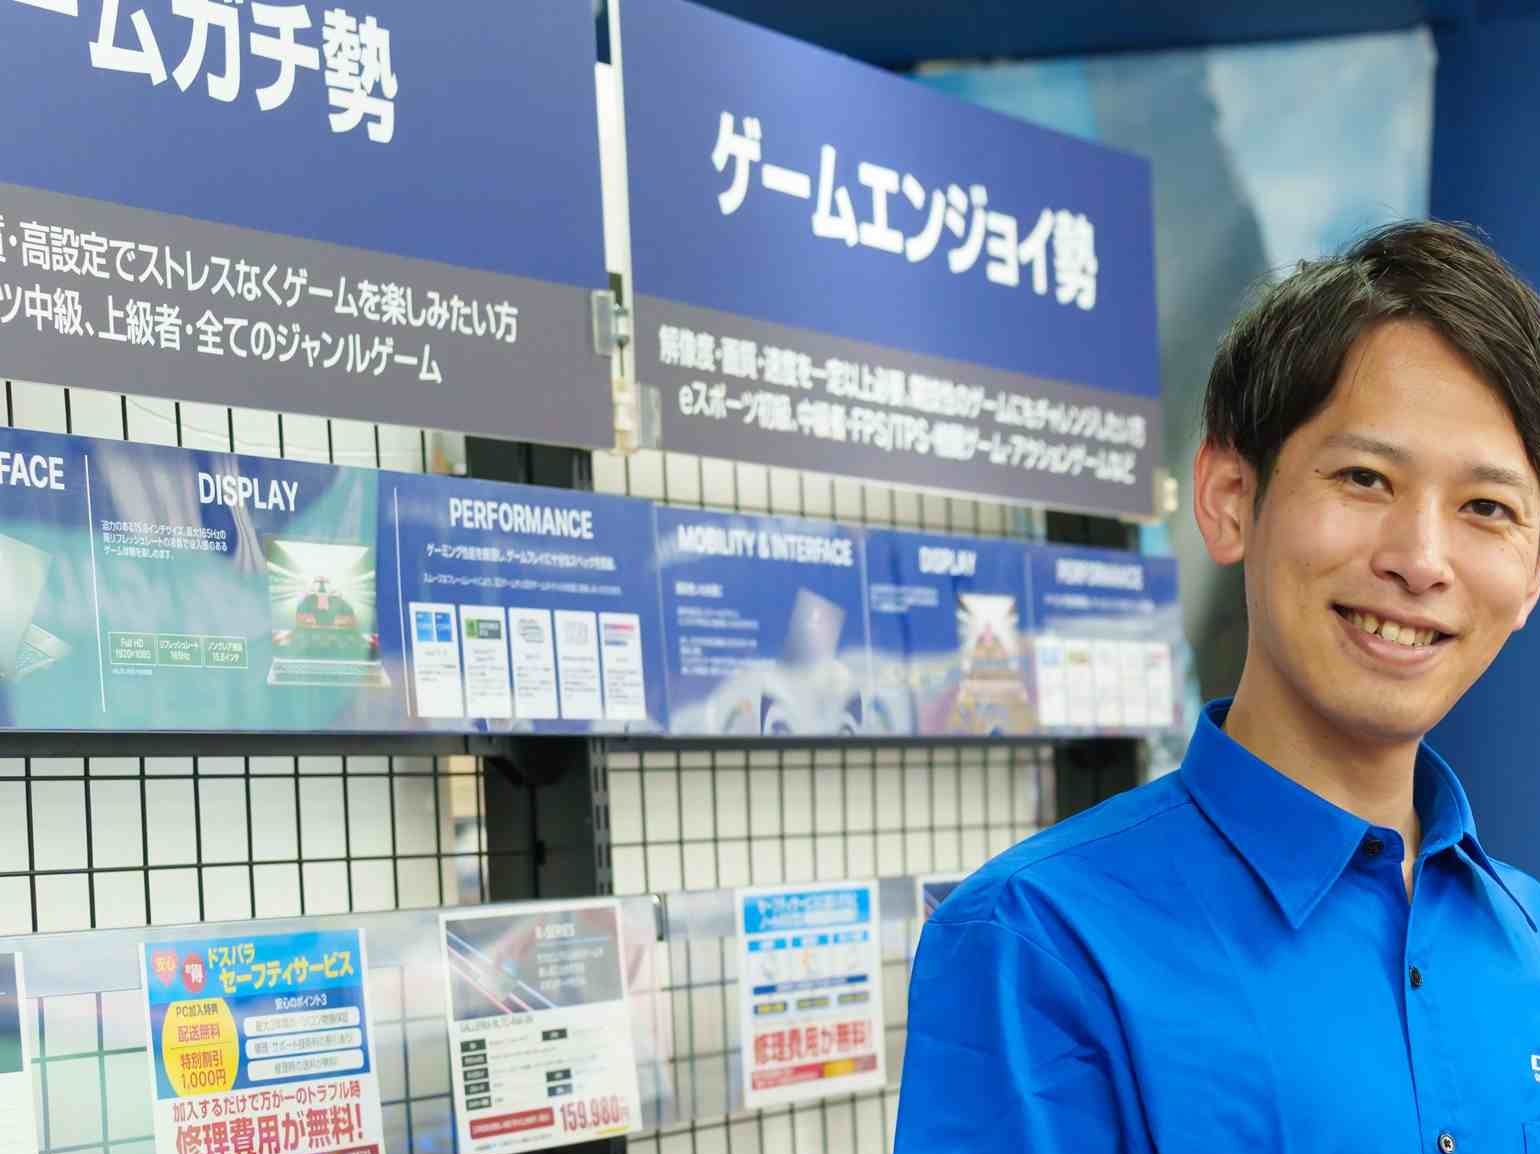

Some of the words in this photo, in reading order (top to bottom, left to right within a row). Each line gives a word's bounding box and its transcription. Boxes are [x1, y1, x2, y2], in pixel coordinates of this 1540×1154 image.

[12, 0, 399, 144] ムガチ勢
[712, 111, 1097, 310] ゲームエンジョイ勢
[0, 215, 518, 343] ・高設定でストレスなくゲームを楽しみたい方
[199, 471, 298, 512] DISPLAY
[449, 497, 594, 540] PERFORMANCE
[677, 524, 756, 558] MOBILITY
[771, 532, 853, 567] INTERFACE
[918, 546, 977, 576] DISPLAY
[208, 943, 255, 969] ドスパラ
[218, 950, 354, 993] セーフティサービス
[177, 1022, 222, 1043] 配送無料
[180, 1047, 224, 1071] 特別割引
